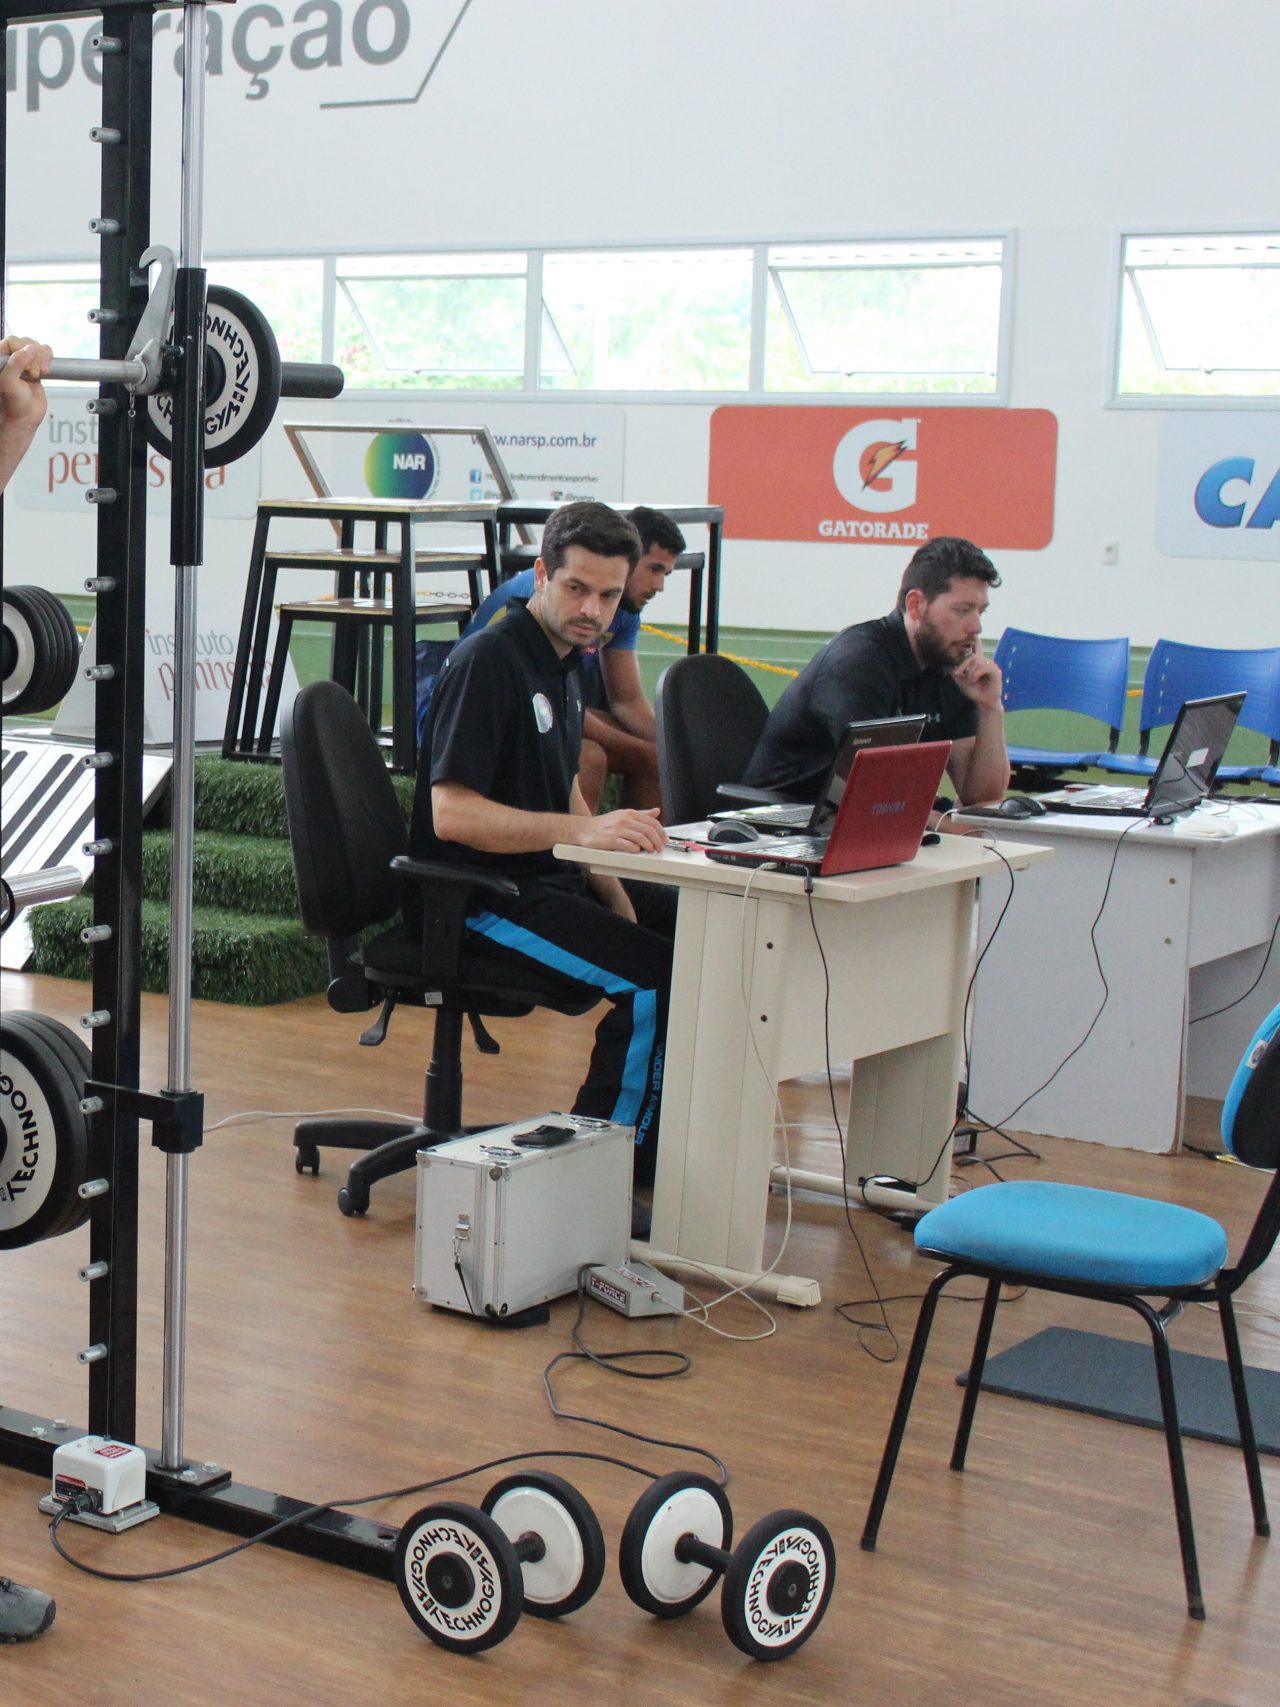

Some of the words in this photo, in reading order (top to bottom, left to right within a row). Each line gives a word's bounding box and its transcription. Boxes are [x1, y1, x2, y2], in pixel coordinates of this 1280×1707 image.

[393, 454, 426, 471] NAR
[471, 433, 597, 450] ww.narsp.com.br
[818, 520, 929, 540] GATORADE
[145, 629, 234, 656] insuto
[652, 1043, 666, 1091] UNDER
[0, 1073, 40, 1202] TECHNOG
[591, 1276, 627, 1303] T-FORCE
[411, 1527, 476, 1602] TECHNOGYM
[786, 1536, 820, 1630] TECHNOGYM
[430, 1556, 495, 1631] TECHNOGYM
[749, 1543, 783, 1638] TECHNOGYM
